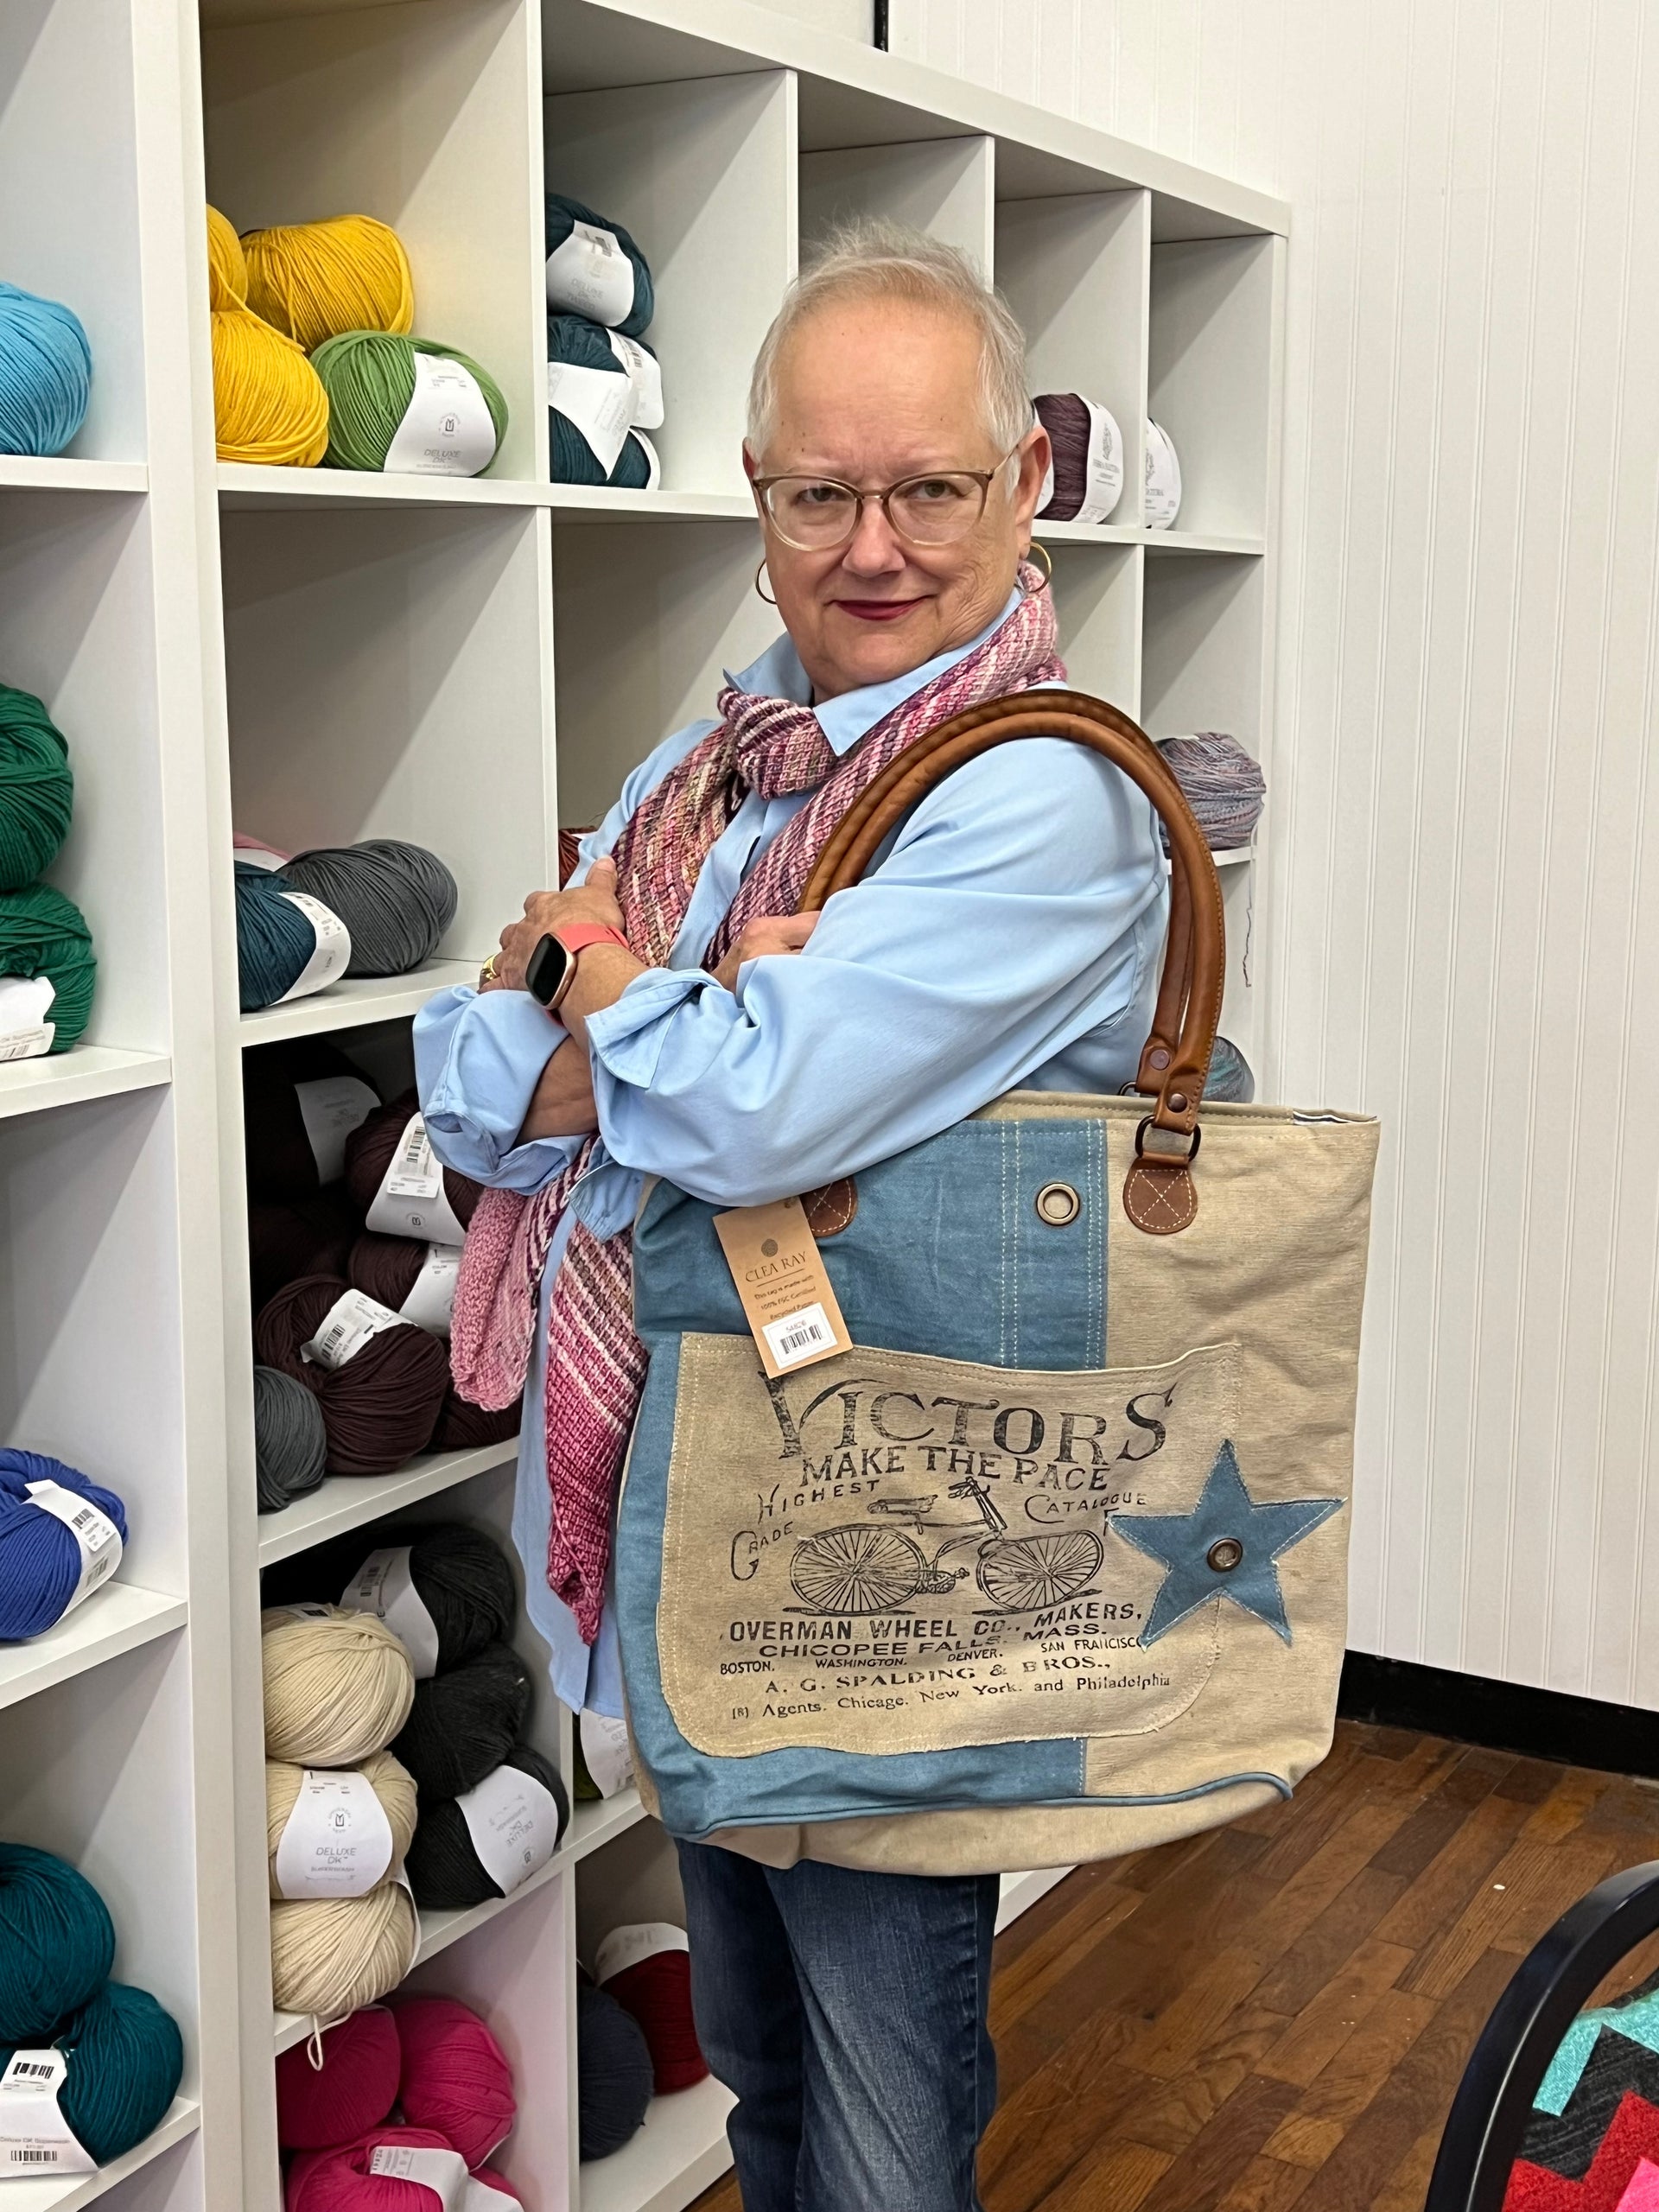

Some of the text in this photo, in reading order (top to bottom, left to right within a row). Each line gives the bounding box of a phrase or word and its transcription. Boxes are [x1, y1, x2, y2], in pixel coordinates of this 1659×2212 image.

[424, 449, 461, 458] DELUXE
[745, 1251, 806, 1283] CLEA RAY
[758, 1370, 1178, 1465] VICTORS
[800, 1446, 1111, 1491] MAKE THE PACE
[758, 1480, 880, 1524] HIGHEST
[1025, 1492, 1147, 1523] CATALOGUE
[731, 1521, 793, 1580] GRADE
[730, 1620, 852, 1641] OVERMAN
[869, 1619, 957, 1638] WHEEL
[1034, 1603, 1141, 1627] MAKERS,
[760, 1642, 908, 1657] CHICOPEE
[1023, 1623, 1107, 1641] MASS.
[720, 1661, 775, 1675] BOSTON.
[816, 1657, 907, 1669] WASHINGTON.
[947, 1649, 1003, 1662] DENVER.
[1040, 1642, 1065, 1652] SAN
[766, 1681, 787, 1694] A.
[800, 1678, 825, 1692] G.
[836, 1668, 976, 1688] SPALDING
[989, 1664, 1007, 1676] &
[918, 1690, 959, 1703] New
[1034, 1679, 1064, 1692] and
[1077, 1672, 1170, 1691] Philadelphia
[315, 1847, 357, 1856] DELUXE
